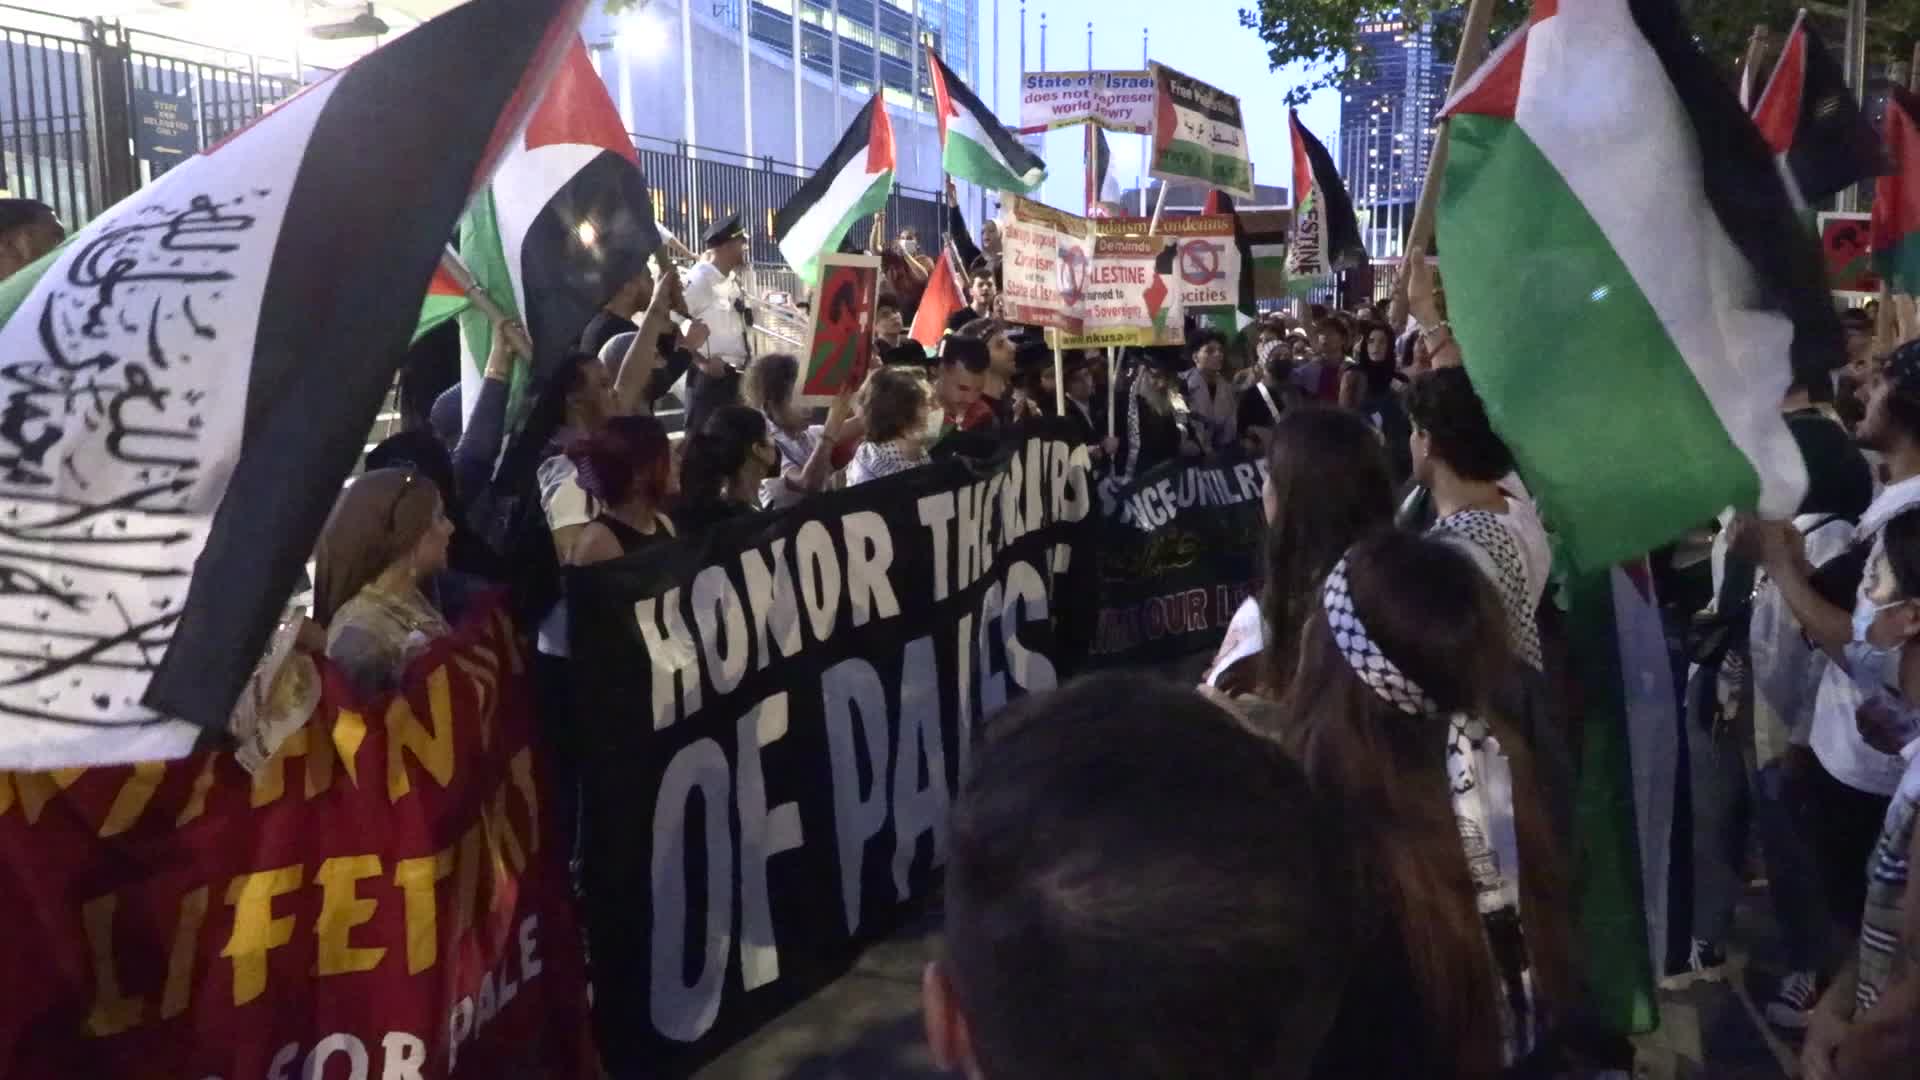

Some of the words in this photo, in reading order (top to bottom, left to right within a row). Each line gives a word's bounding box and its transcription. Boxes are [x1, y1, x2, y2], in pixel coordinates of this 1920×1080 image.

[1026, 75, 1072, 89] State
[1078, 73, 1094, 86] of
[1024, 91, 1058, 105] does
[1062, 89, 1089, 100] not
[1052, 101, 1091, 115] world
[1116, 289, 1125, 301] to
[634, 508, 902, 732] HONOR
[650, 690, 805, 1043] OF
